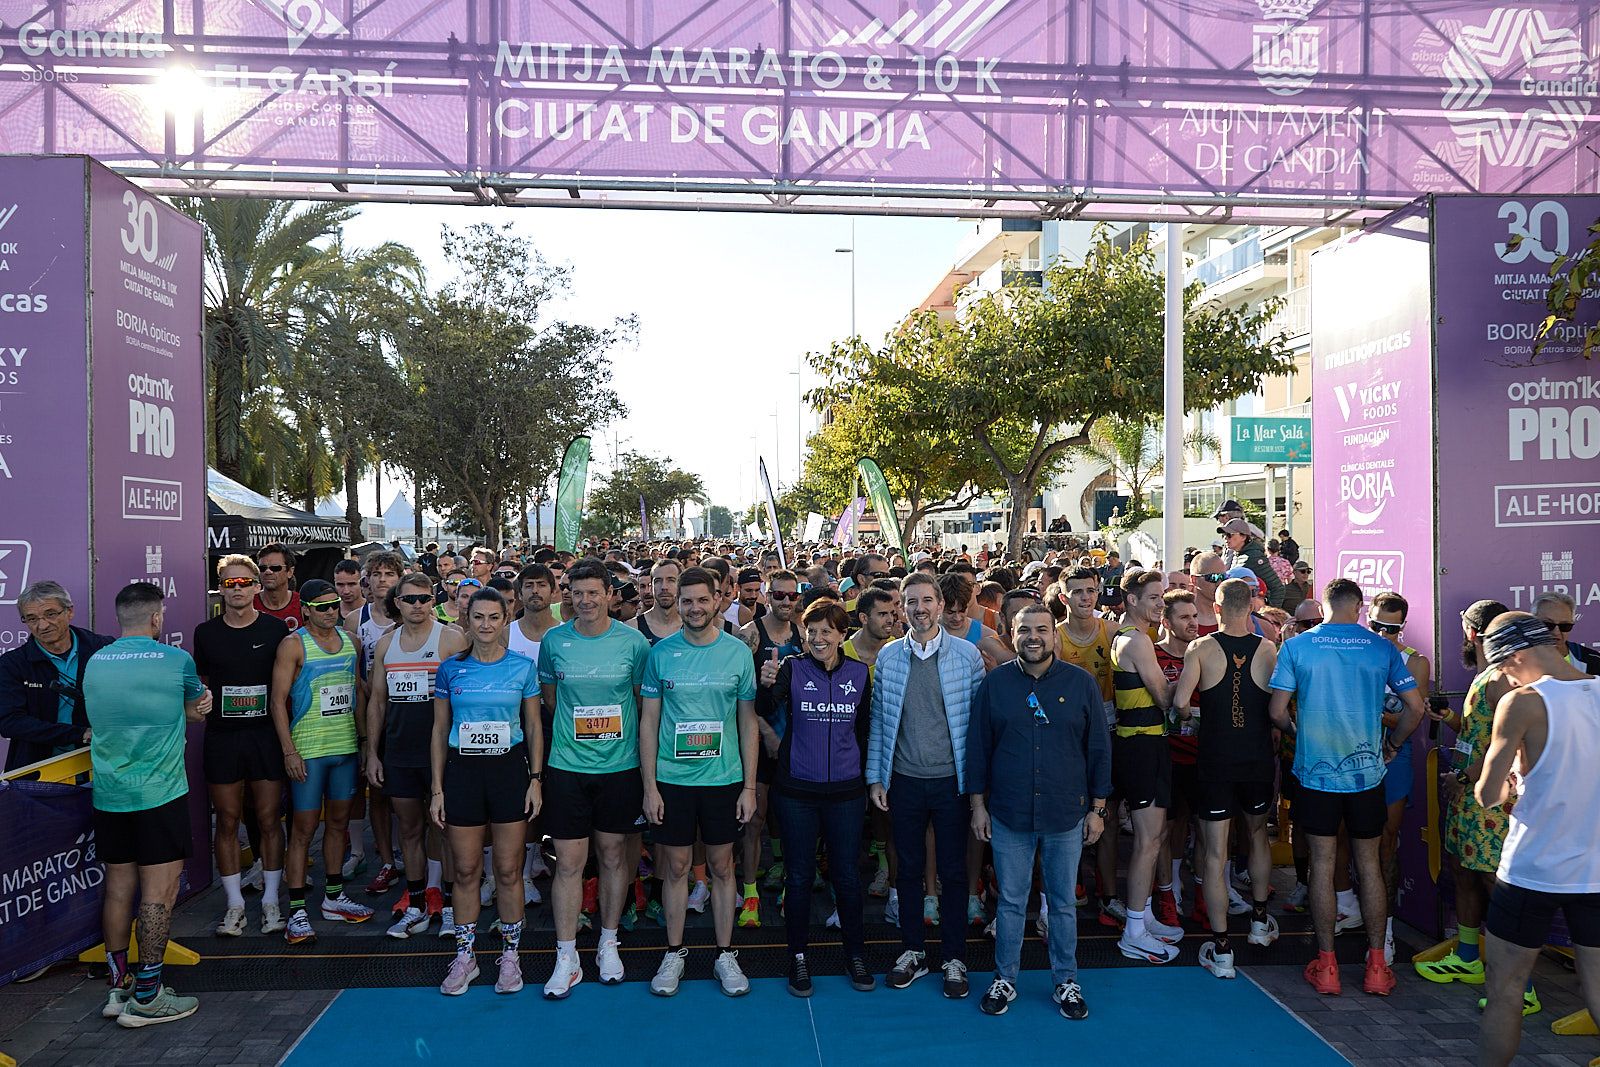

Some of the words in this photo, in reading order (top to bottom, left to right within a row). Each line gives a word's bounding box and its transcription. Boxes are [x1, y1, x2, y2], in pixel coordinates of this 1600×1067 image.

[18, 21, 166, 59] Gandia
[21, 69, 80, 84] Sports
[493, 40, 632, 83] MITJA
[863, 54, 893, 91] &
[911, 54, 961, 94] 10
[976, 56, 1002, 94] K
[267, 61, 398, 98] GARBÍ
[1519, 75, 1598, 98] Gandia
[274, 117, 338, 127] GANDIA
[494, 98, 656, 143] CIUTAT
[670, 103, 726, 144] DE
[741, 105, 932, 151] GANDIA
[1178, 107, 1386, 142] AJUNTAMENT
[1195, 143, 1234, 171] DE
[1244, 144, 1371, 175] GANDIA
[120, 190, 158, 263] 30
[1494, 200, 1570, 264] 30
[120, 260, 138, 278] MITJA
[1494, 273, 1527, 285] MITJA
[124, 278, 144, 295] CIUTAT
[144, 286, 152, 299] DE
[152, 291, 175, 308] GANDIA
[1502, 289, 1540, 301] CIUTAT
[116, 309, 149, 337] BORJA
[149, 323, 181, 348] ópticos
[1504, 346, 1533, 355] BORJA
[1359, 381, 1402, 406] VICKY
[1363, 403, 1398, 420] FOODS
[129, 398, 175, 459] PRO
[1236, 424, 1250, 442] La
[1253, 424, 1277, 442] Mar
[1279, 424, 1304, 442] Salá
[1343, 427, 1390, 447] FUNDACIÓN
[1508, 405, 1600, 461] PRO
[128, 487, 177, 511] ALE-HOP
[1340, 470, 1396, 507] BORJA
[1343, 559, 1396, 586] 42K
[395, 681, 418, 692] 2291
[329, 694, 349, 707] 2400
[801, 701, 816, 712] EL
[586, 717, 610, 730] 3477
[470, 734, 499, 745] 2353
[686, 733, 713, 746] 3001
[85, 843, 96, 862] &
[16, 888, 44, 918] DE
